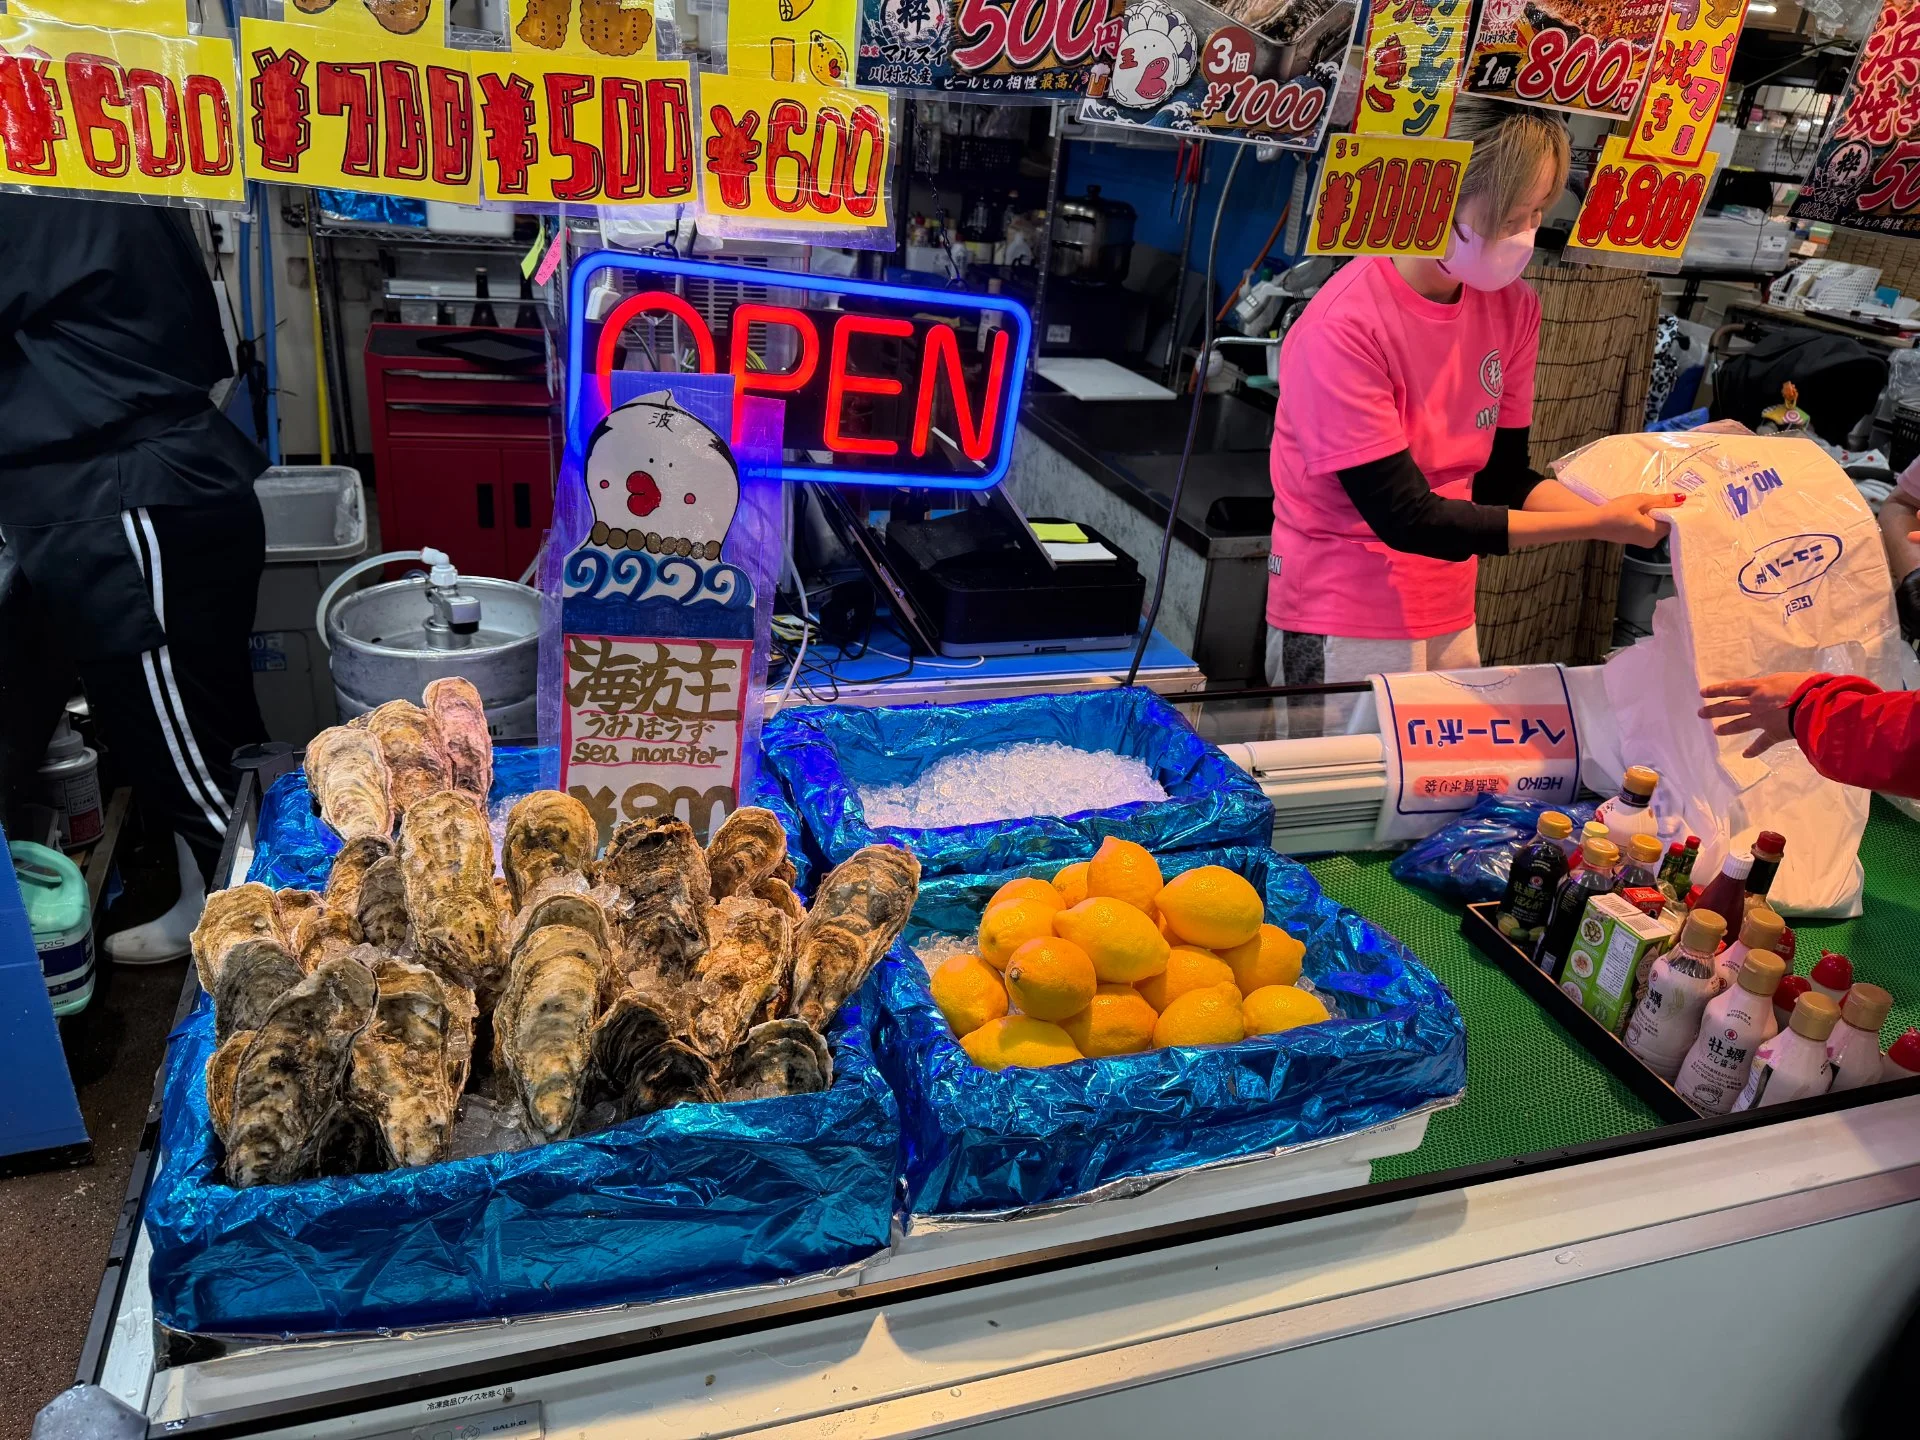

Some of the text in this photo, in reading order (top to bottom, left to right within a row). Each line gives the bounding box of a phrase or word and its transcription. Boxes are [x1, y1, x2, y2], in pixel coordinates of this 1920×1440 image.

[1478, 29, 1518, 45] 川村水産
[1208, 37, 1250, 75] 3個
[1478, 57, 1512, 87] 1個
[868, 66, 933, 86] 川村水産
[943, 73, 1078, 91] ビールとの相性最高!
[0, 44, 234, 178] ¥600
[250, 47, 471, 187] ¥700
[1200, 75, 1327, 131] ¥1000
[477, 73, 692, 201] ¥500
[706, 98, 882, 217] ¥600
[1317, 157, 1461, 250] ¥1000
[1575, 164, 1706, 250] ¥800
[596, 290, 1009, 461] OPEN
[648, 411, 675, 433] 波
[564, 635, 742, 722] 海坊主
[585, 713, 716, 746] うみぼうず
[1407, 718, 1567, 748] ヘイコーポリ
[571, 742, 728, 764] sea monster
[1517, 776, 1563, 791] HEIKO
[1708, 1036, 1747, 1063] 牡蠣
